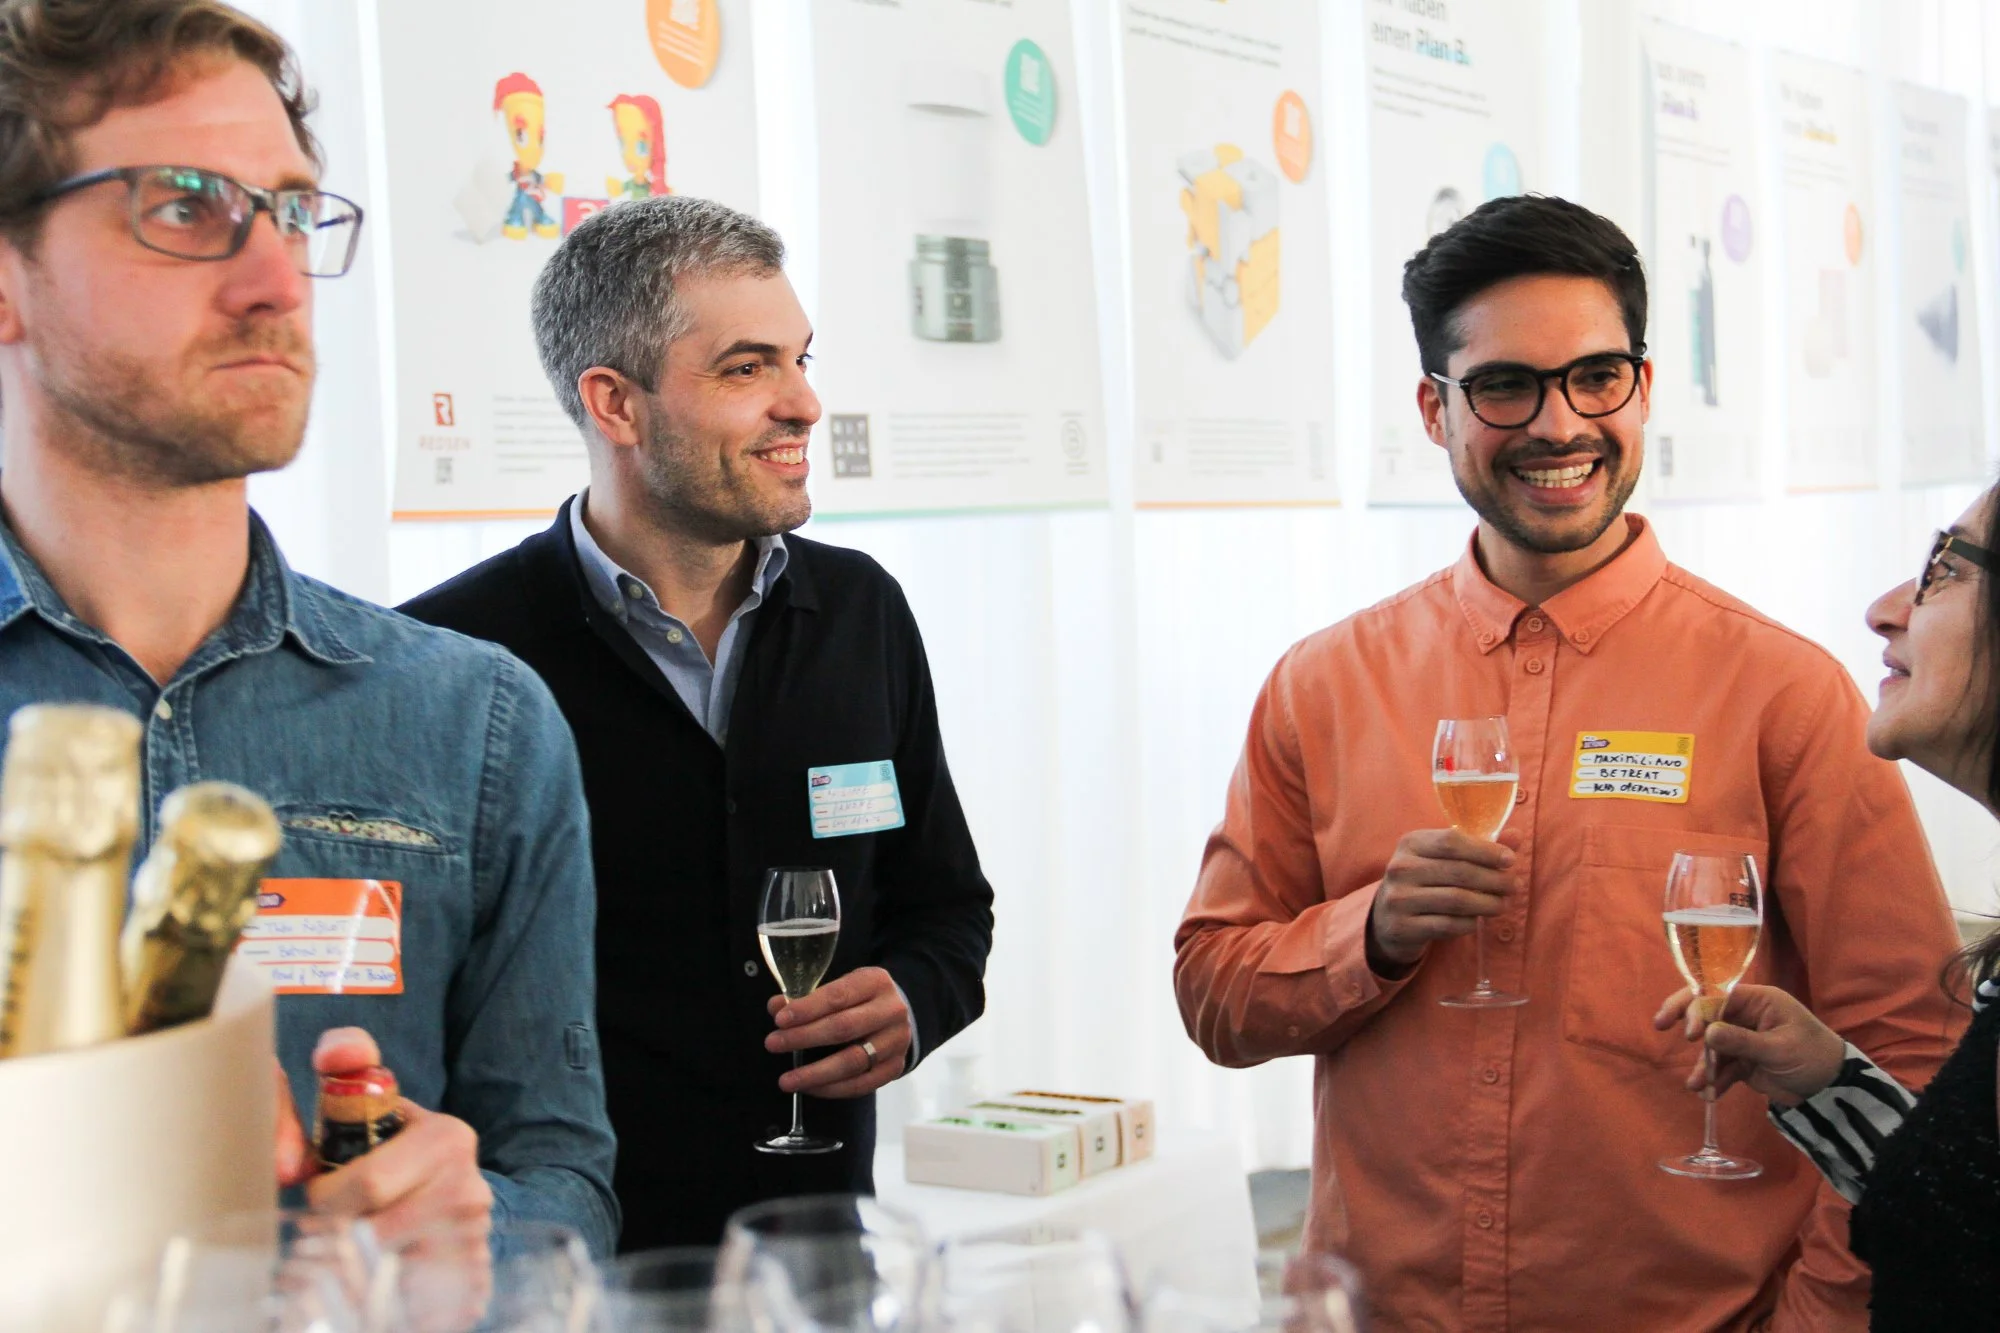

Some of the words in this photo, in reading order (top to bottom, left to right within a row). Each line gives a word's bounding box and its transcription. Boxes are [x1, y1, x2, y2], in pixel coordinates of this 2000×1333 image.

[1372, 17, 1411, 50] einen
[1415, 27, 1450, 61] Plan
[1600, 768, 1660, 780] BETREAT
